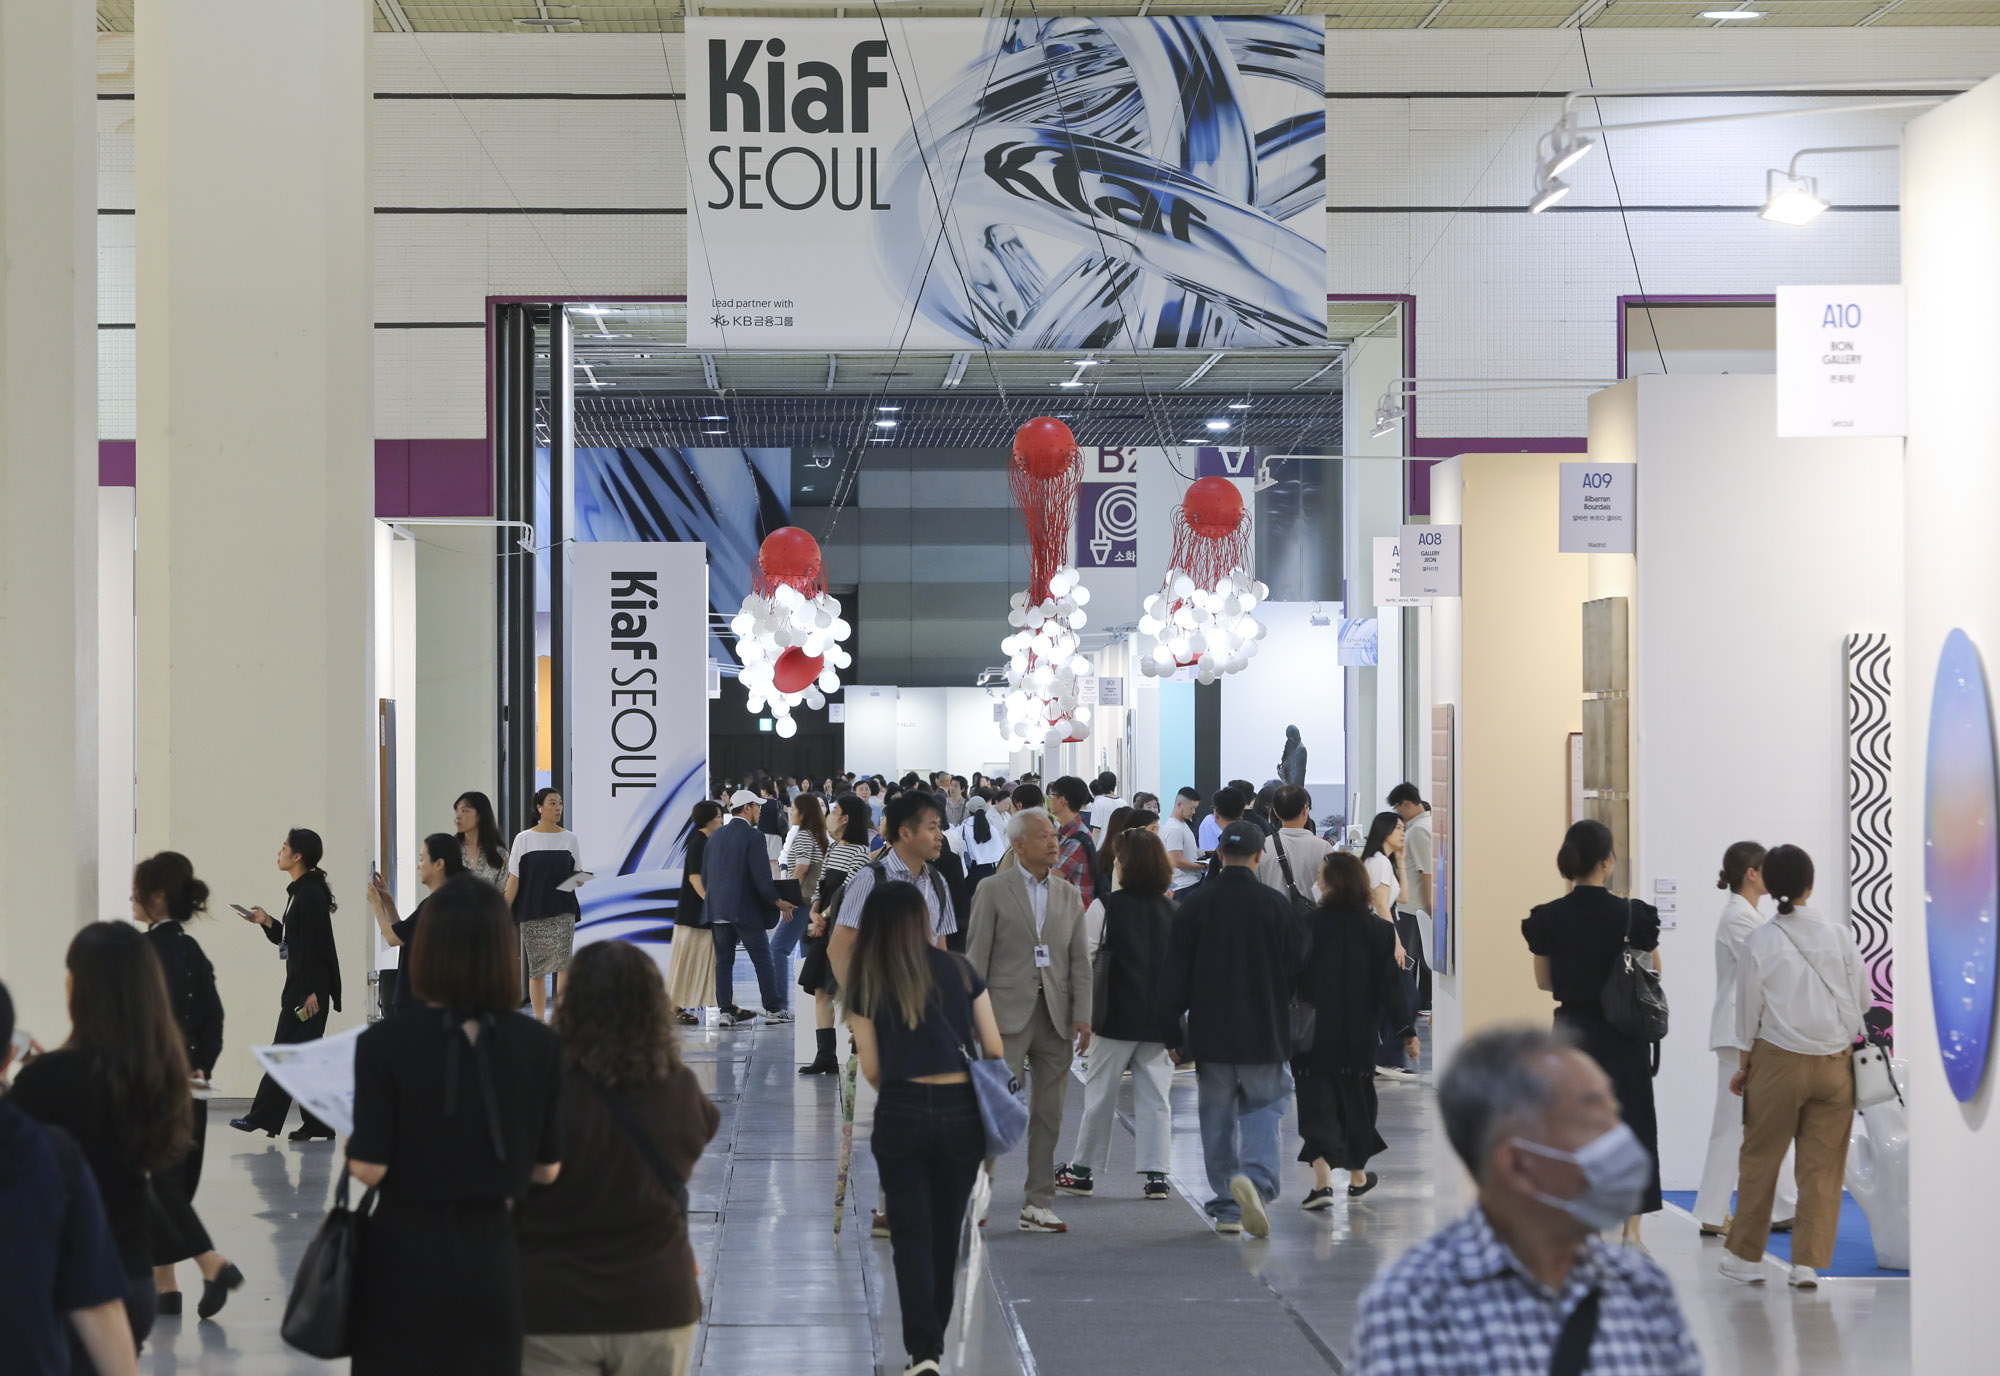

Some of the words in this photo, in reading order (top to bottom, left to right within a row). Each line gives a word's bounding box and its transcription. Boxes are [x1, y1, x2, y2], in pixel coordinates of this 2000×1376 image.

[708, 38, 888, 133] Kiaf
[708, 146, 891, 211] SEOUL
[736, 299, 771, 309] partner
[773, 298, 794, 308] with
[1822, 303, 1862, 329] A10
[1822, 354, 1862, 365] GALLERY
[1582, 473, 1613, 489] A09
[1418, 533, 1442, 545] A08
[610, 570, 658, 660] Kiaf
[611, 667, 658, 798] SEOUL
